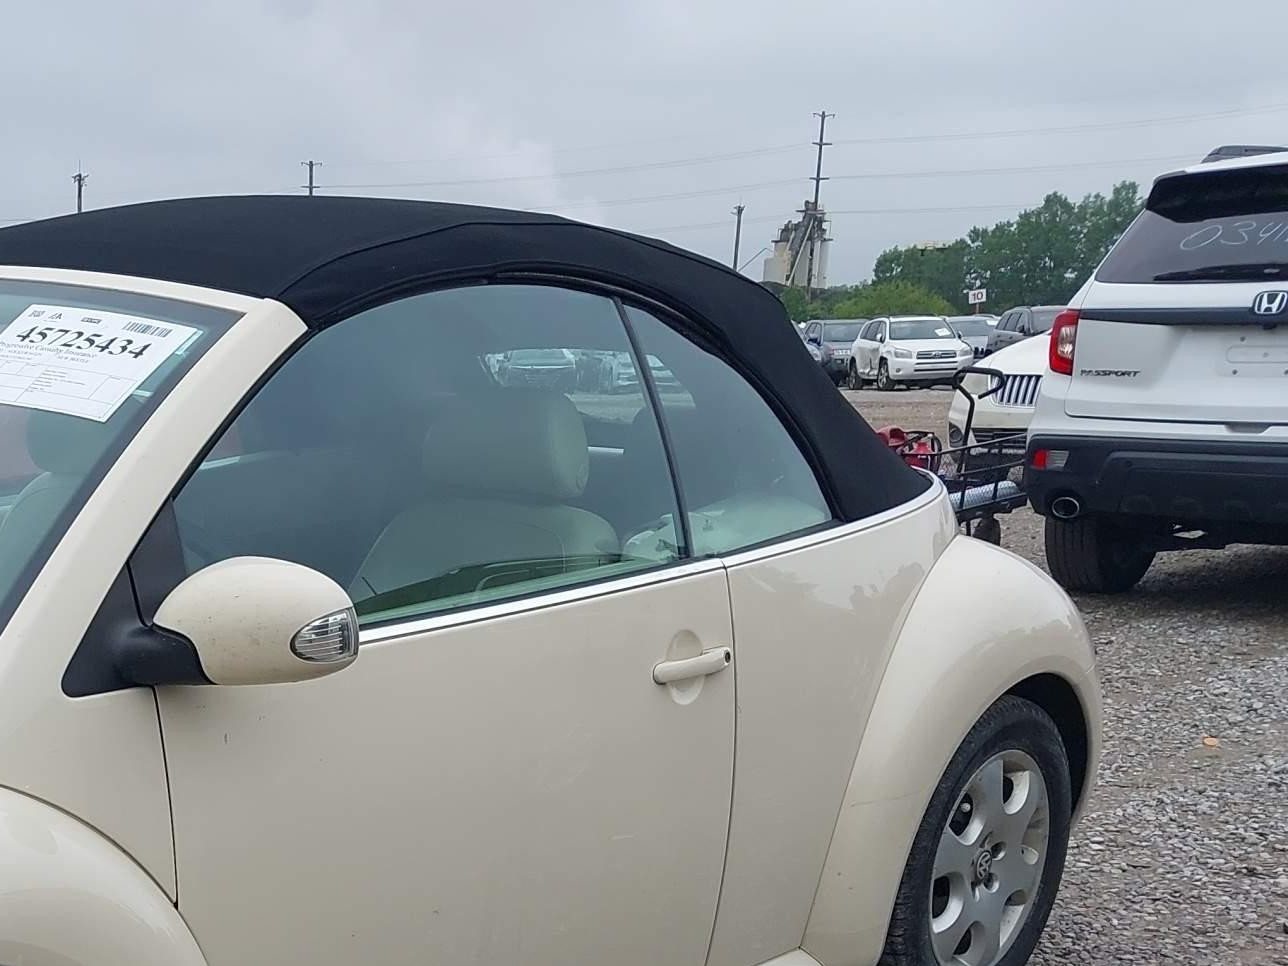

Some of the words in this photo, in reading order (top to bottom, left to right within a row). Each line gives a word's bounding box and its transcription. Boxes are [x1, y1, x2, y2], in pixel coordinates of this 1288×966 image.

[972, 291, 983, 302] 10
[16, 325, 152, 359] 45725434
[1080, 369, 1141, 377] PASSPORT
